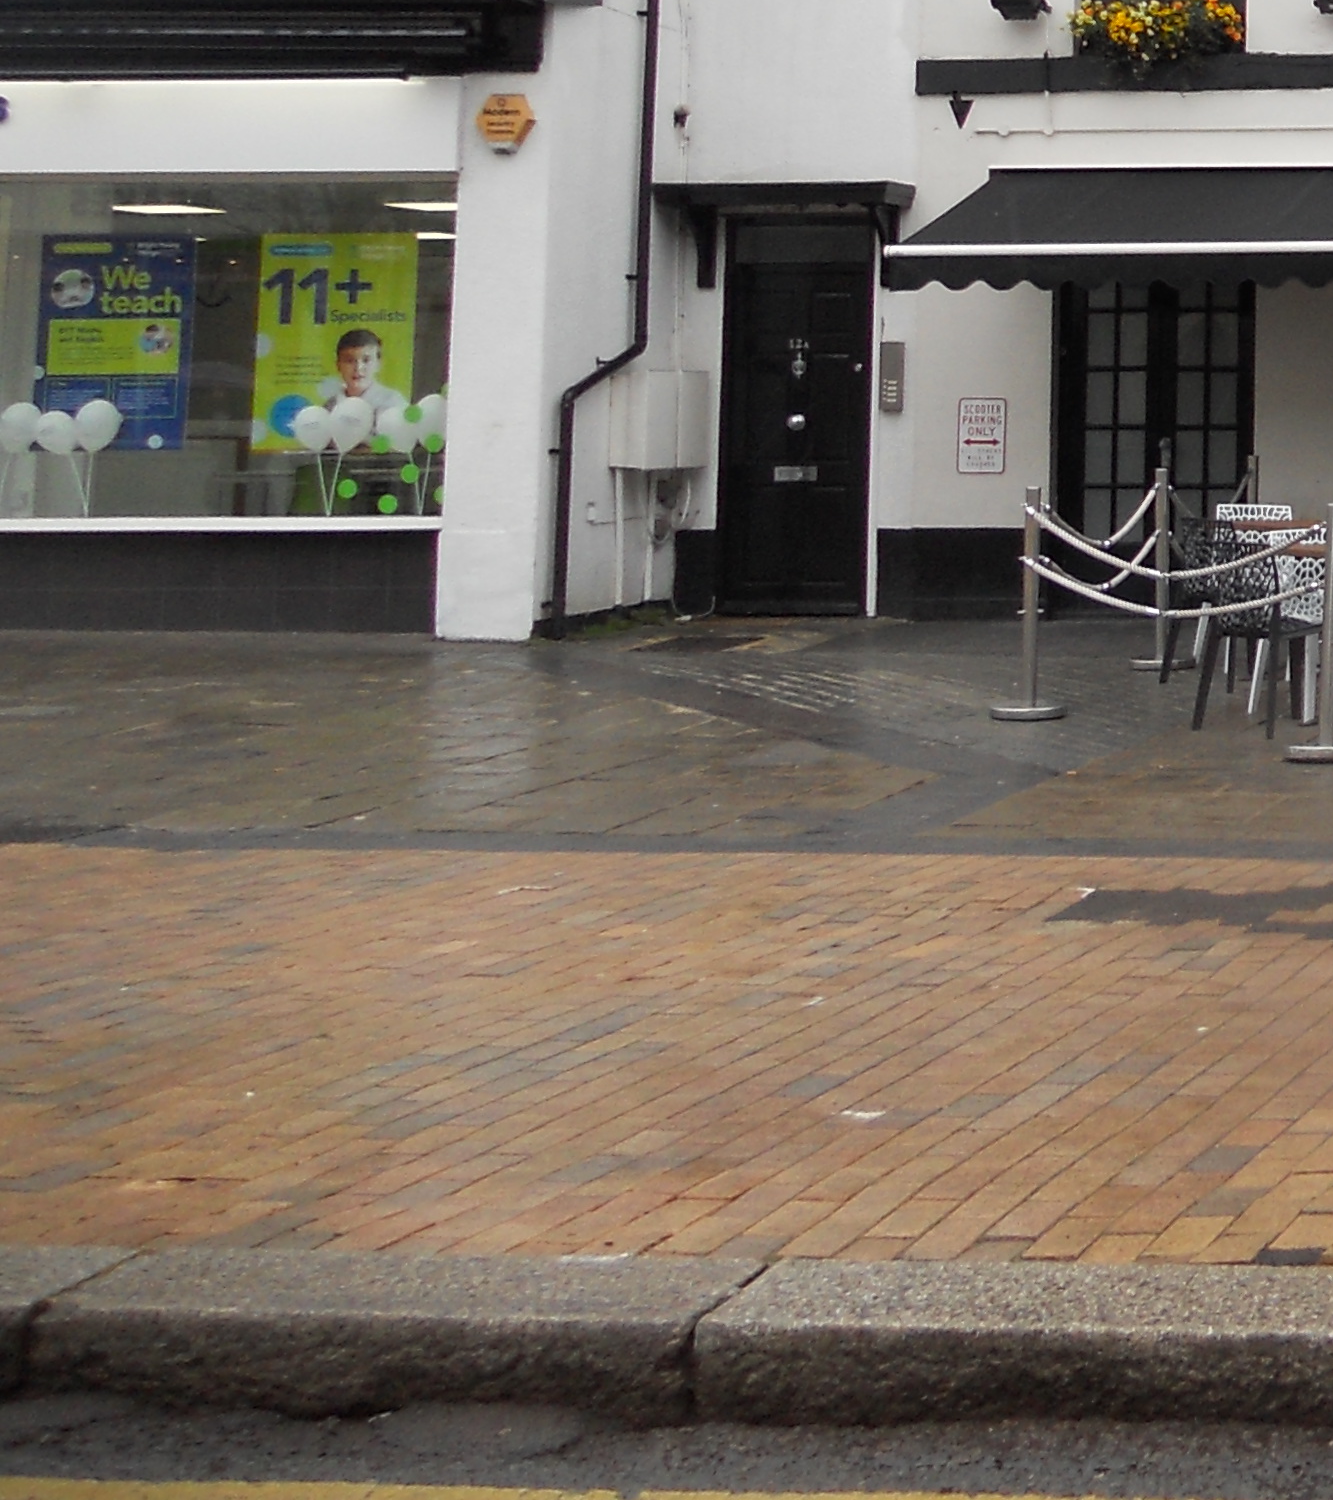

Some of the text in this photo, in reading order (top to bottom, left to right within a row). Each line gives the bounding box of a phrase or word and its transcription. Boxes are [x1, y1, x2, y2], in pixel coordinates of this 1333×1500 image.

[102, 266, 151, 290] We
[100, 286, 184, 314] teach
[263, 267, 373, 325] 11+
[330, 308, 407, 323] Specialists
[963, 404, 1001, 414] SCOOTER
[962, 415, 1003, 425] PARKING
[967, 426, 996, 436] ONLY
